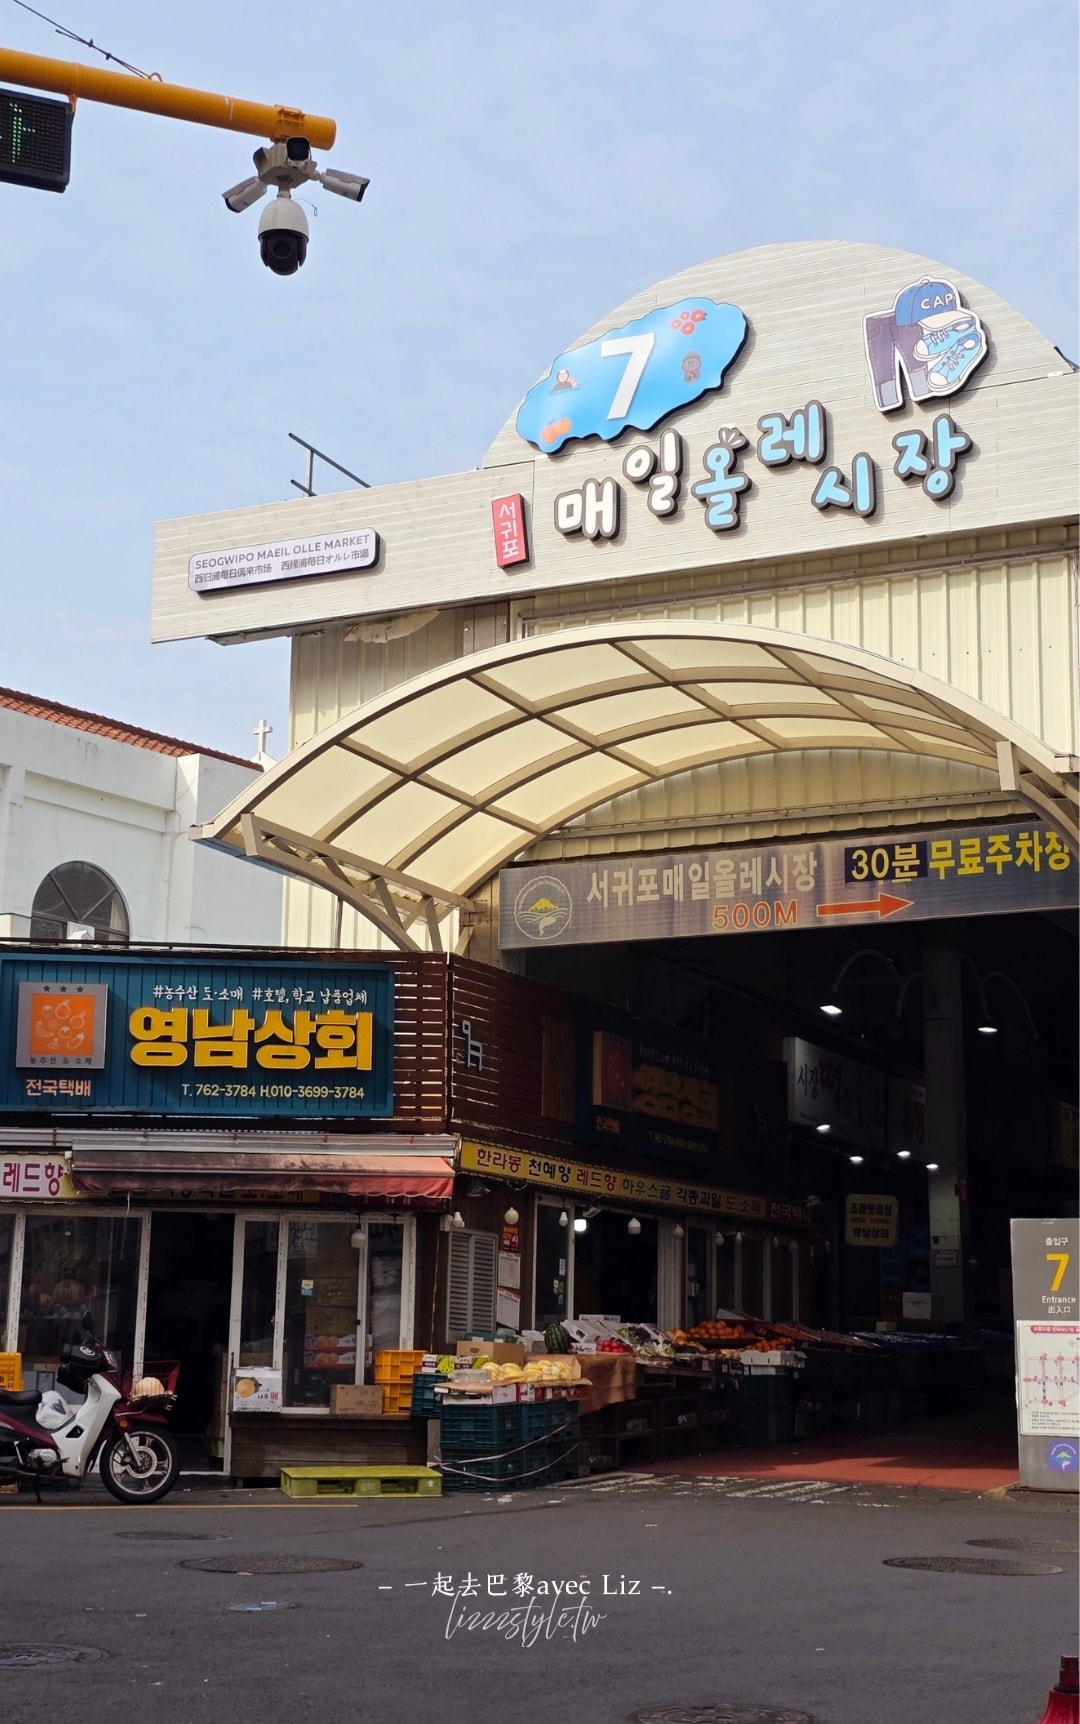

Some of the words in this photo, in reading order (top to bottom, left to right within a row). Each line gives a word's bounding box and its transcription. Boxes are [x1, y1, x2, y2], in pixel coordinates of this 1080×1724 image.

[920, 293, 953, 310] CAP
[600, 332, 655, 420] 7
[499, 501, 520, 560] 서귀포
[194, 551, 255, 570] SEOGWIPO
[257, 547, 291, 561] MAEIL
[292, 541, 322, 555] OLLE
[324, 533, 371, 551] MARKET
[586, 851, 818, 908] 서귀포매일올레시장
[850, 843, 921, 881] 30분
[928, 830, 1071, 881] 무료주차장
[711, 898, 798, 931] 500M
[153, 984, 199, 1002] #농수산
[291, 988, 317, 1005] 학교
[319, 988, 369, 1006] 납품업체
[129, 1007, 374, 1071] 영남상회
[25, 1078, 92, 1097] 전국택배
[195, 1083, 257, 1098] 762-3784
[2, 1161, 64, 1197] 레드향
[477, 1147, 522, 1174] 한라봉
[528, 1158, 572, 1184] 천혜향
[576, 1167, 617, 1193] 레드향
[676, 1186, 722, 1209] 각종과일
[1045, 1236, 1069, 1246] 출입구
[1046, 1253, 1070, 1292] 7
[1041, 1295, 1077, 1304] Entrance
[1047, 1305, 1071, 1315] 出入口
